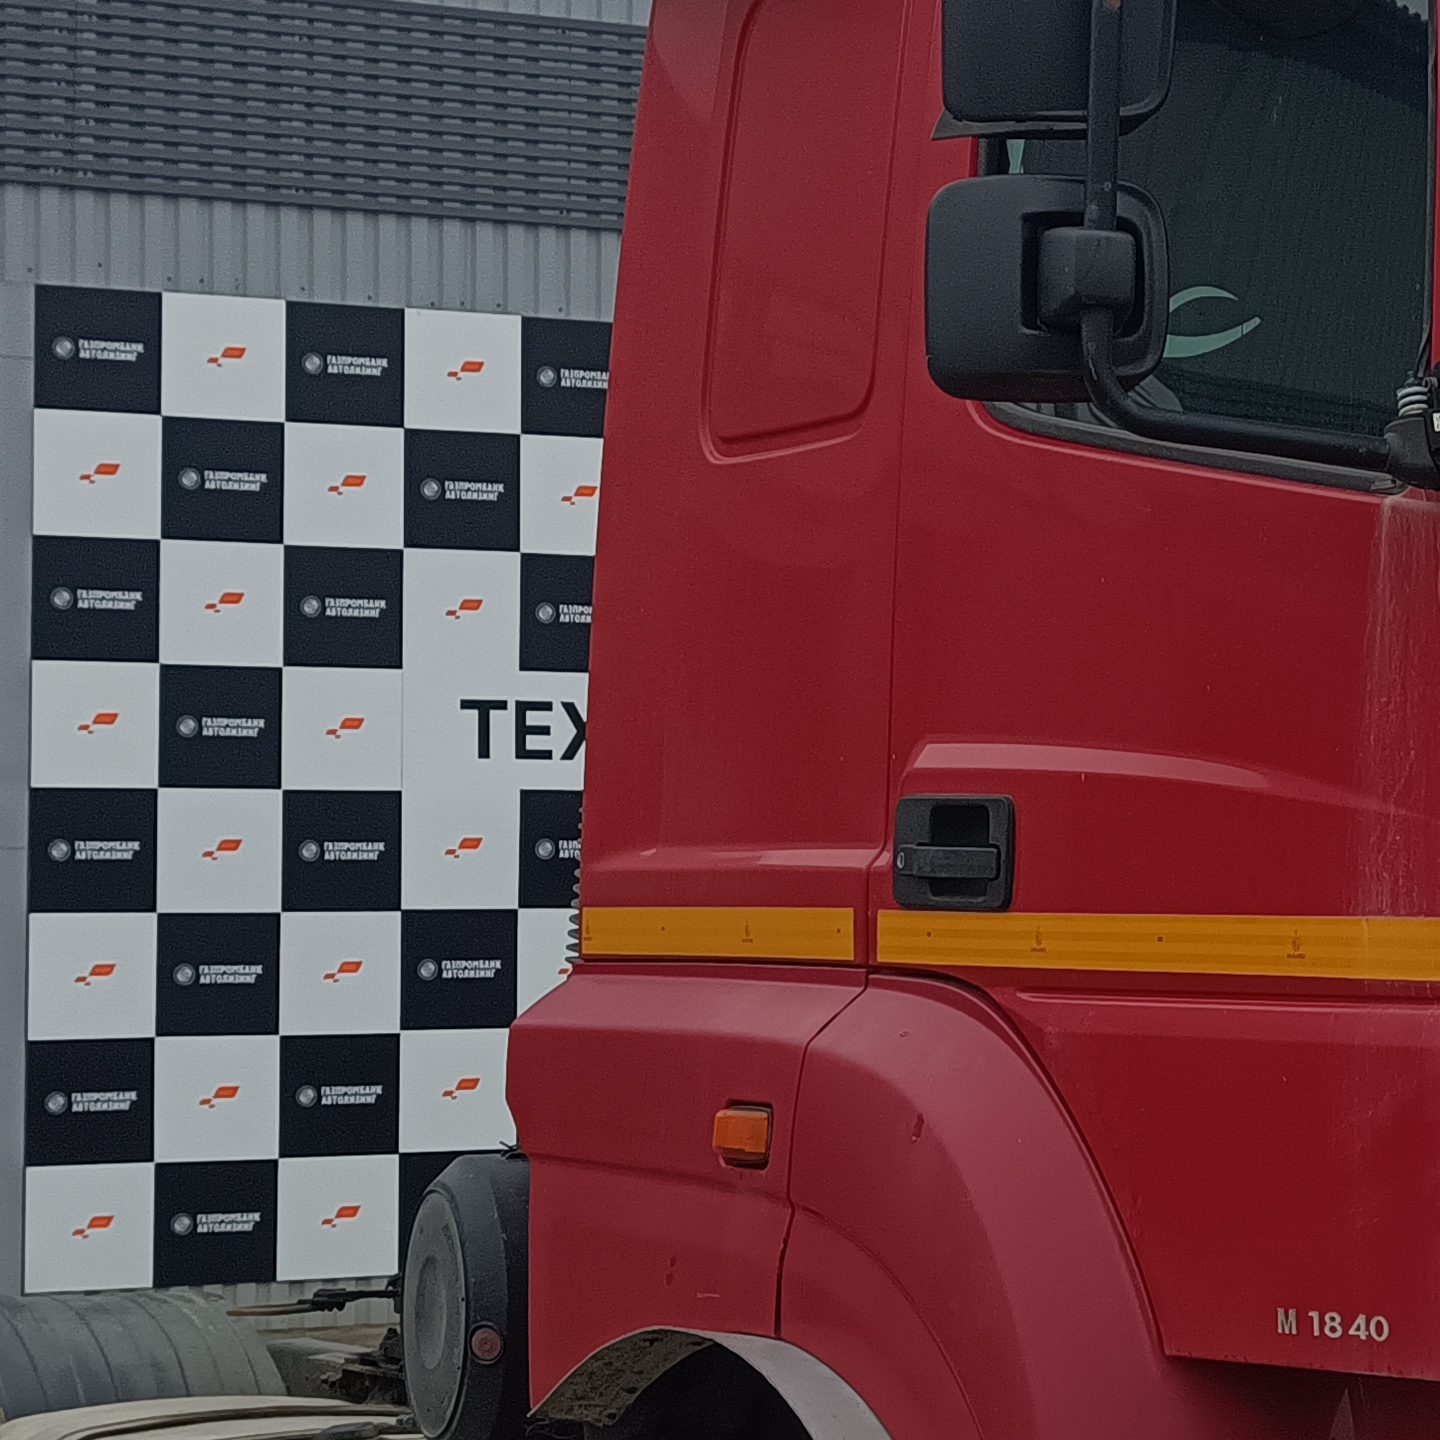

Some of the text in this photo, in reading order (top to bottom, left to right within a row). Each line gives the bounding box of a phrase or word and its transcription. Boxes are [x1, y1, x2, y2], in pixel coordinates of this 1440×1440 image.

[459, 698, 586, 760] ТЕХ
[1276, 1307, 1390, 1343] M 1840
